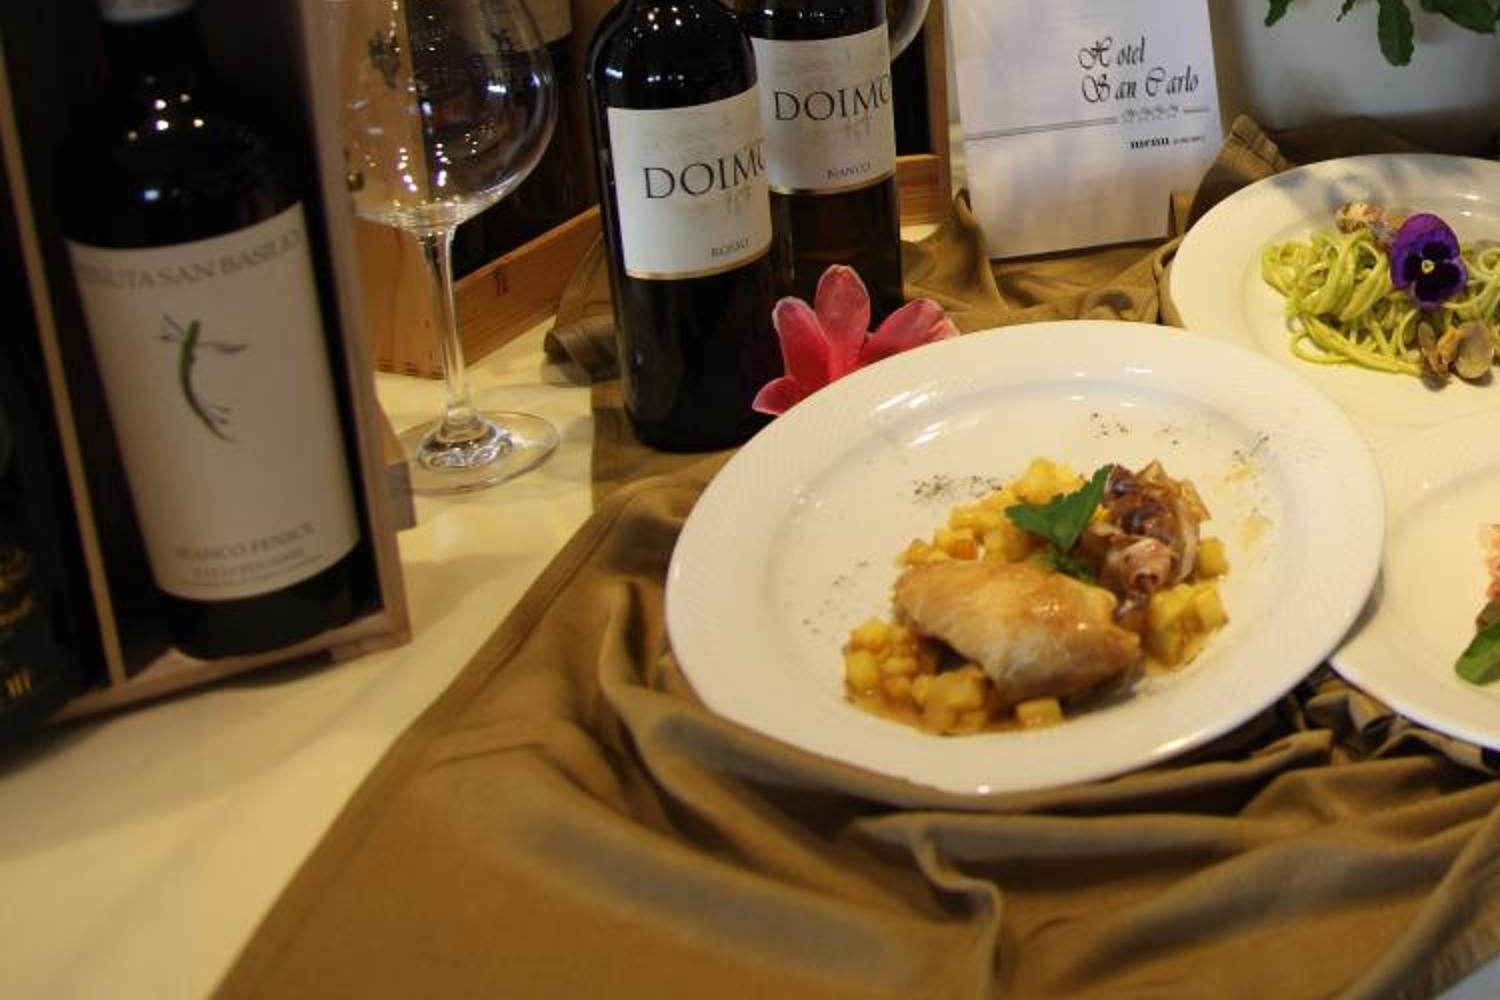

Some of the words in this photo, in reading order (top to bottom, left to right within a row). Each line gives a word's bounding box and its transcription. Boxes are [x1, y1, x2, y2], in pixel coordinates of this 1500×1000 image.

[1077, 36, 1146, 70] Hotel
[1080, 74, 1137, 104] San
[1145, 65, 1199, 98] Carlo
